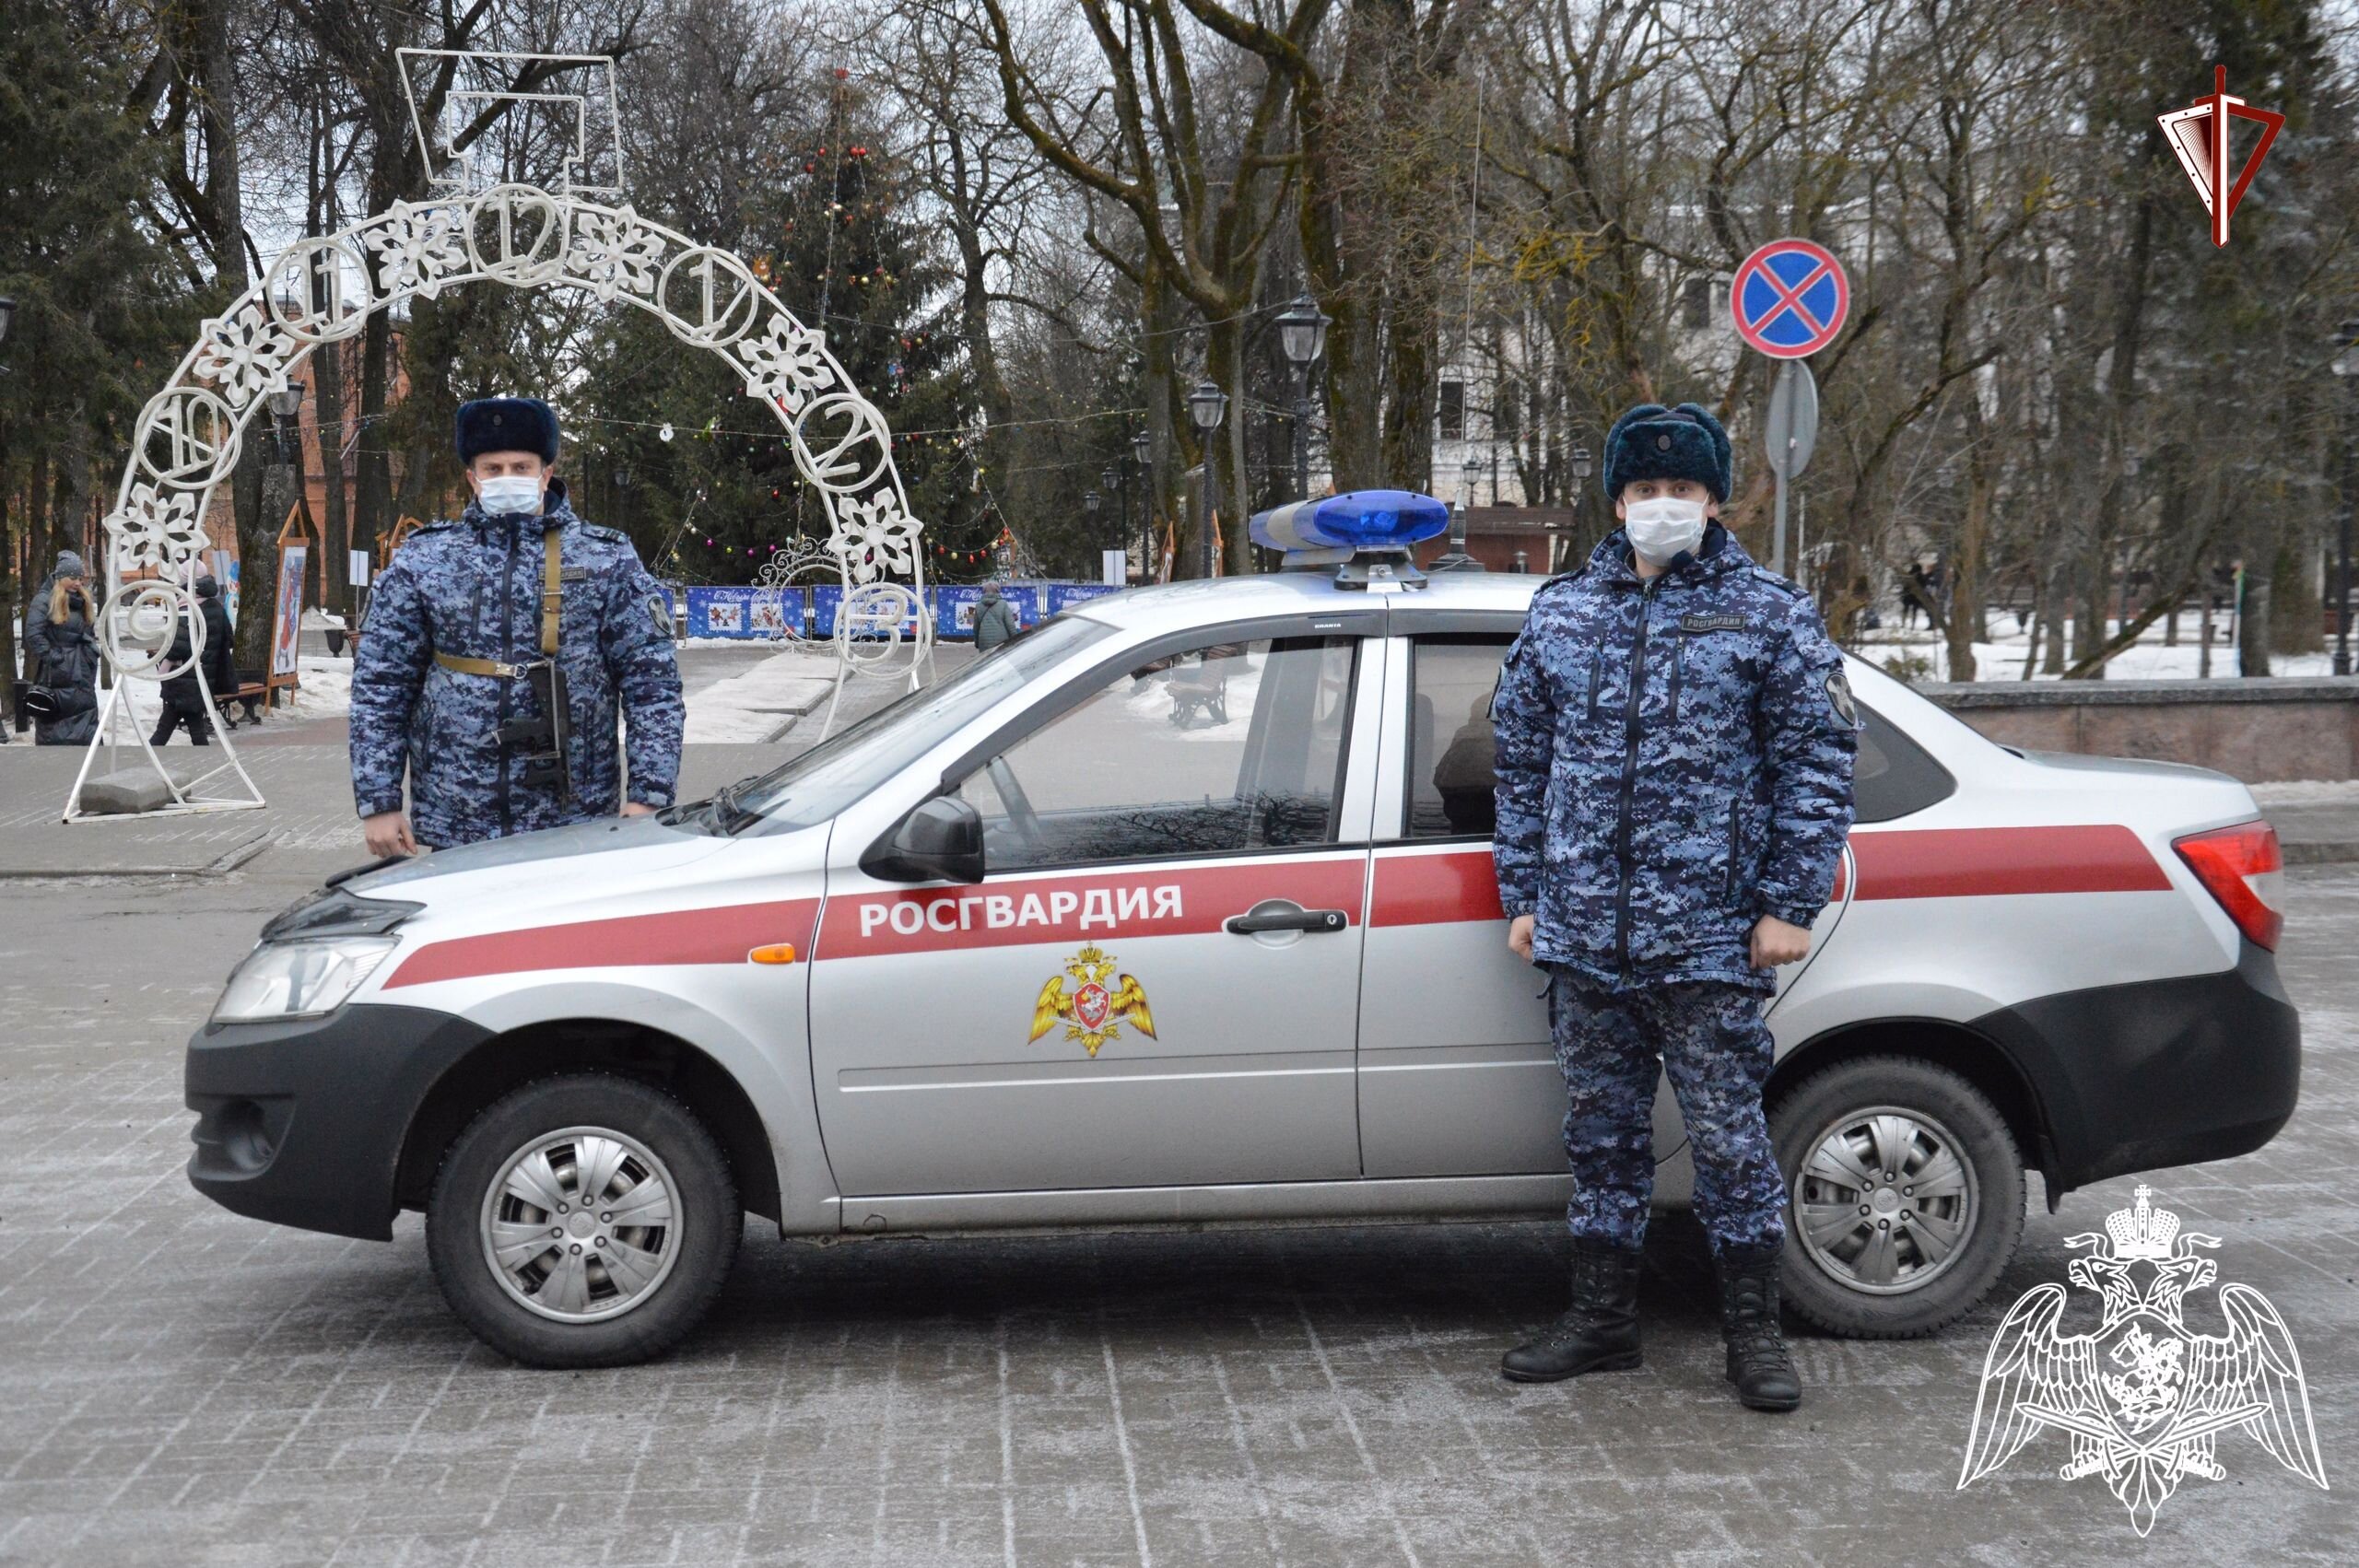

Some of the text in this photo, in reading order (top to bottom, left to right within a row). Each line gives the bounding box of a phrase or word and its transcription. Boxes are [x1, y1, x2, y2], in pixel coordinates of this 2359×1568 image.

[486, 194, 564, 276] 12
[281, 246, 361, 330] 11
[689, 245, 726, 338] 1
[156, 394, 220, 478] 10
[816, 401, 863, 477] 2
[118, 588, 179, 673] 9
[863, 591, 907, 662] 3
[1687, 616, 1741, 627] РОСГВАРДИЯ
[860, 884, 1183, 937] РОСГВАРДИЯ
